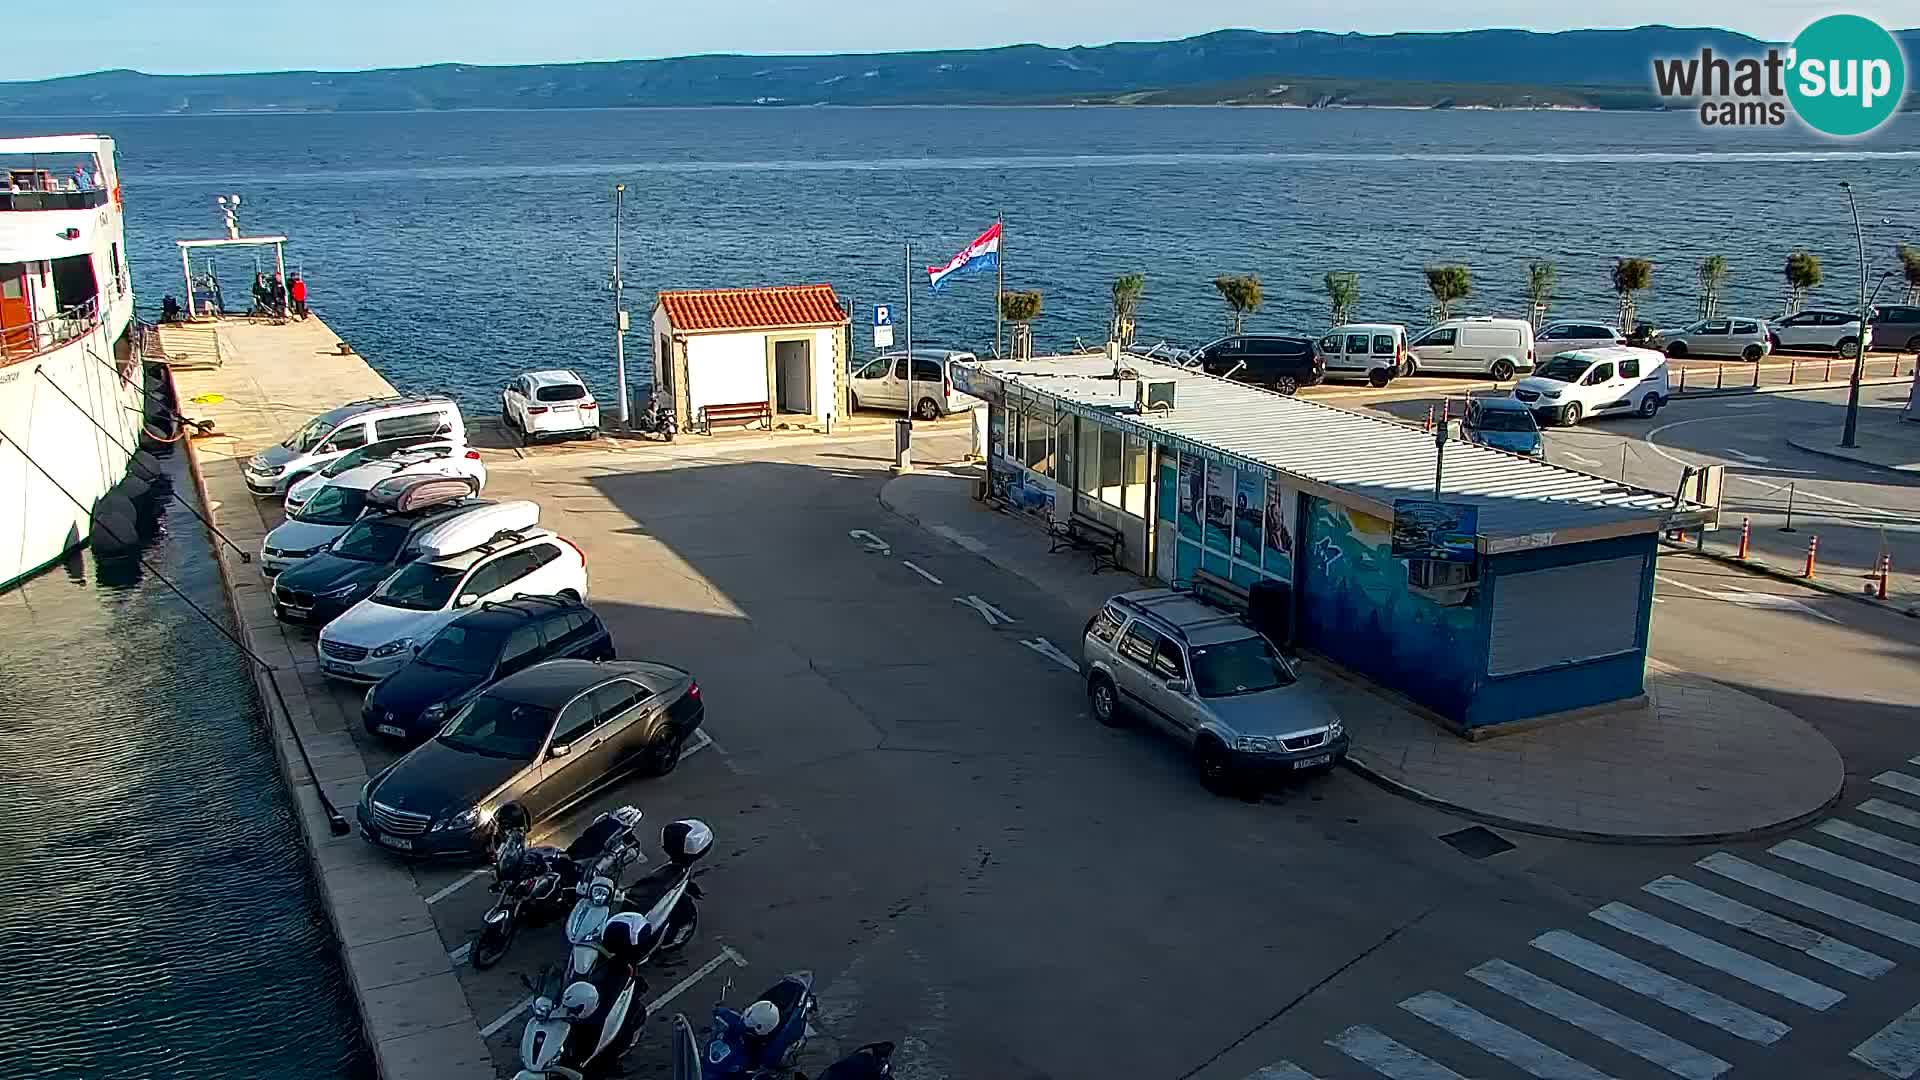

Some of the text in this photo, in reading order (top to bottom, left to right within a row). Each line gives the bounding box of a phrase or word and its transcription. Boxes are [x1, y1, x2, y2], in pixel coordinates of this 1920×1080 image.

[1190, 443, 1219, 462] STATION
[1222, 454, 1245, 471] TICKET
[1247, 462, 1272, 479] OFFICE
